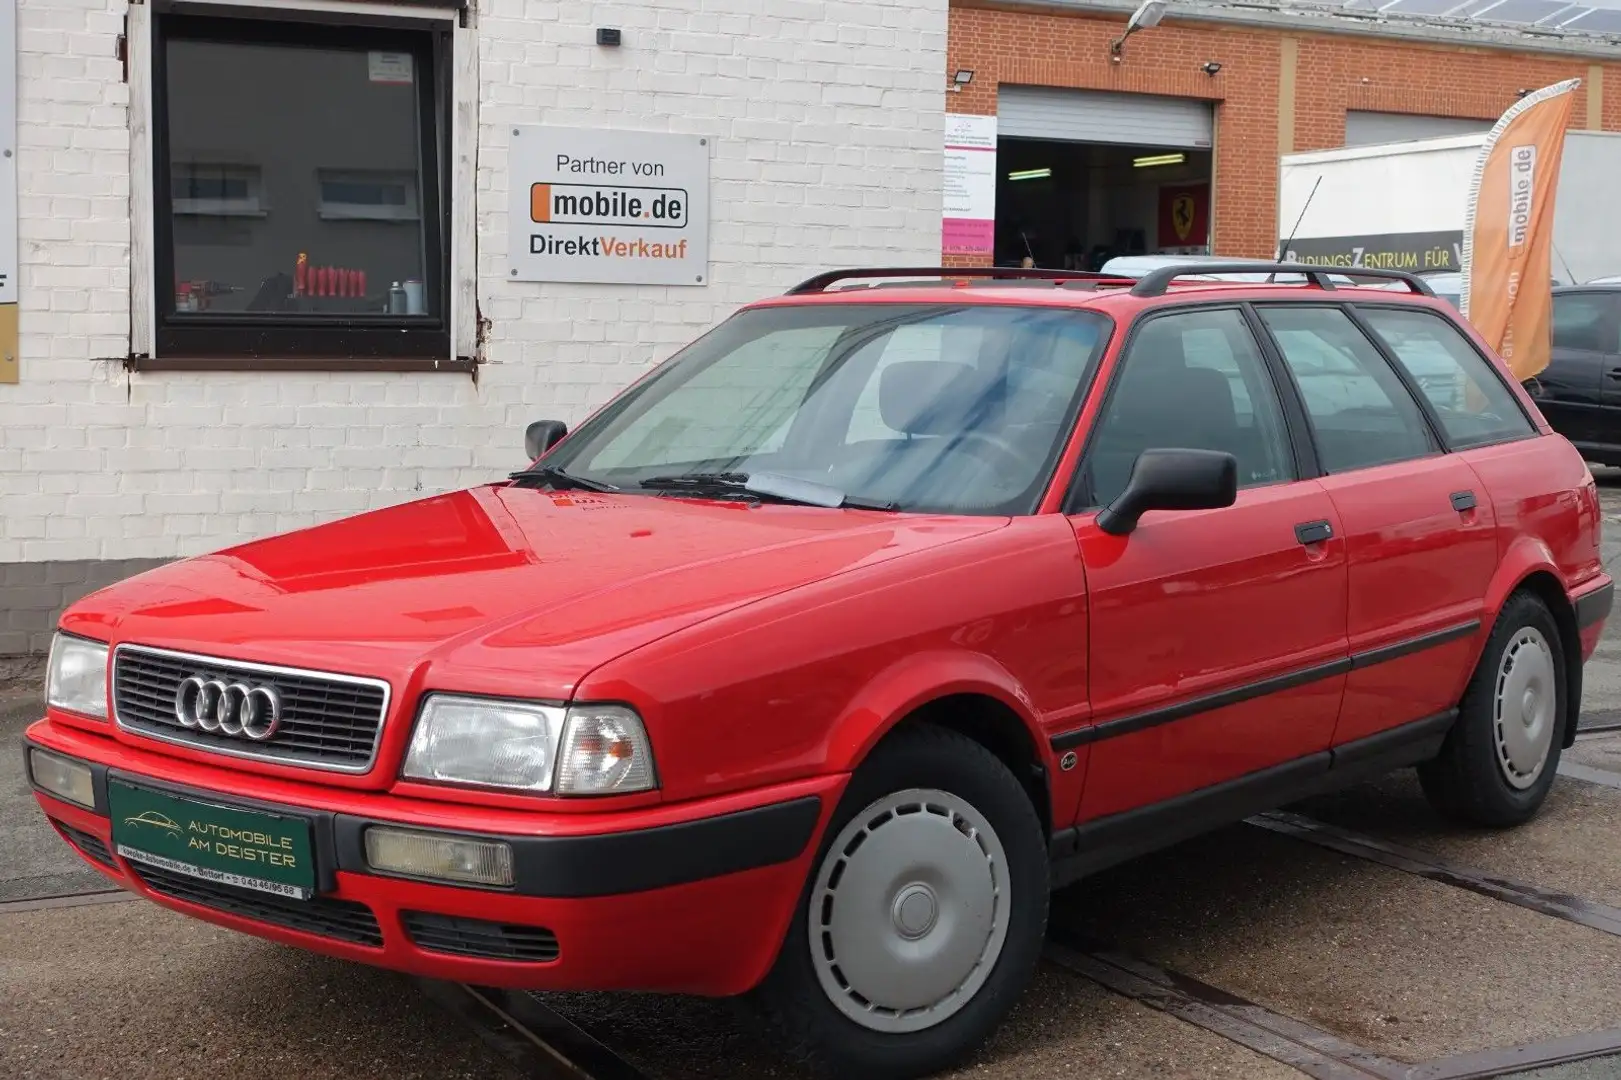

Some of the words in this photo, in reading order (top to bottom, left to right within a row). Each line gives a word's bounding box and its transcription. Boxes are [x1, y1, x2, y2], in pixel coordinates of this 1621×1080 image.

[556, 154, 627, 175] Partner
[632, 162, 665, 177] von
[553, 190, 682, 220] mobile.de
[1513, 149, 1532, 243] mobile.de
[529, 234, 688, 259] DirektVerkauf
[1424, 246, 1449, 268] FÜR
[188, 820, 293, 850] AUTOMOBILE
[188, 837, 211, 852] AM
[215, 842, 297, 868] DEISTER
